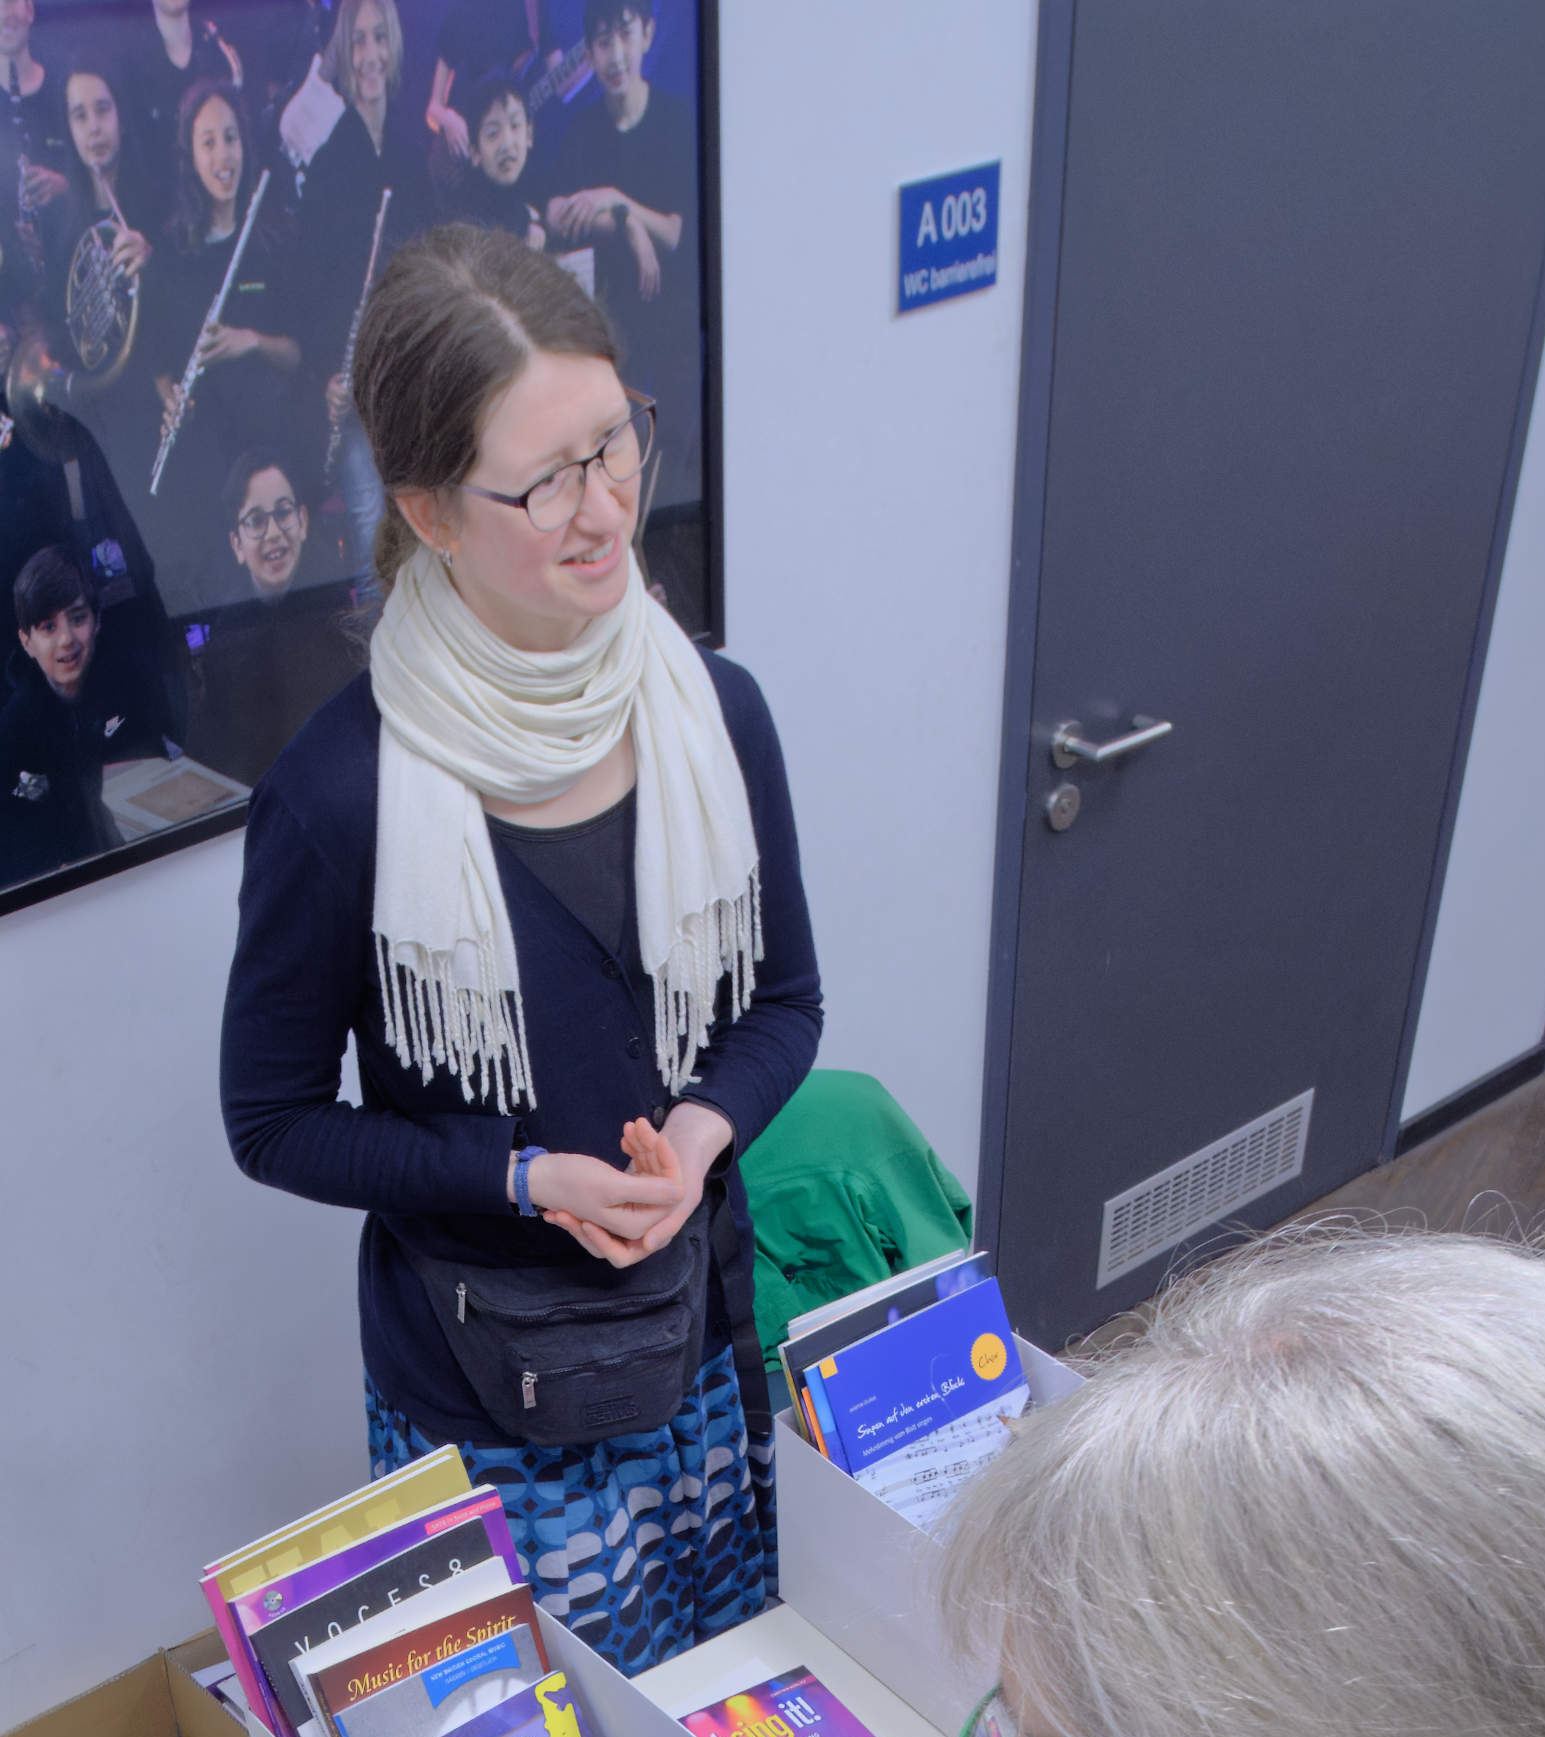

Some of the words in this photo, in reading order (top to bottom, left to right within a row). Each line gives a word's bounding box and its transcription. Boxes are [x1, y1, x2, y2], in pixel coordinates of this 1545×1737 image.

[917, 202, 938, 248] A
[942, 187, 986, 240] 003
[904, 269, 929, 298] WC
[348, 1661, 403, 1702] Music
[407, 1650, 432, 1683] for
[435, 1635, 462, 1661] the
[466, 1615, 516, 1649] Spirit
[778, 1697, 822, 1728] it!
